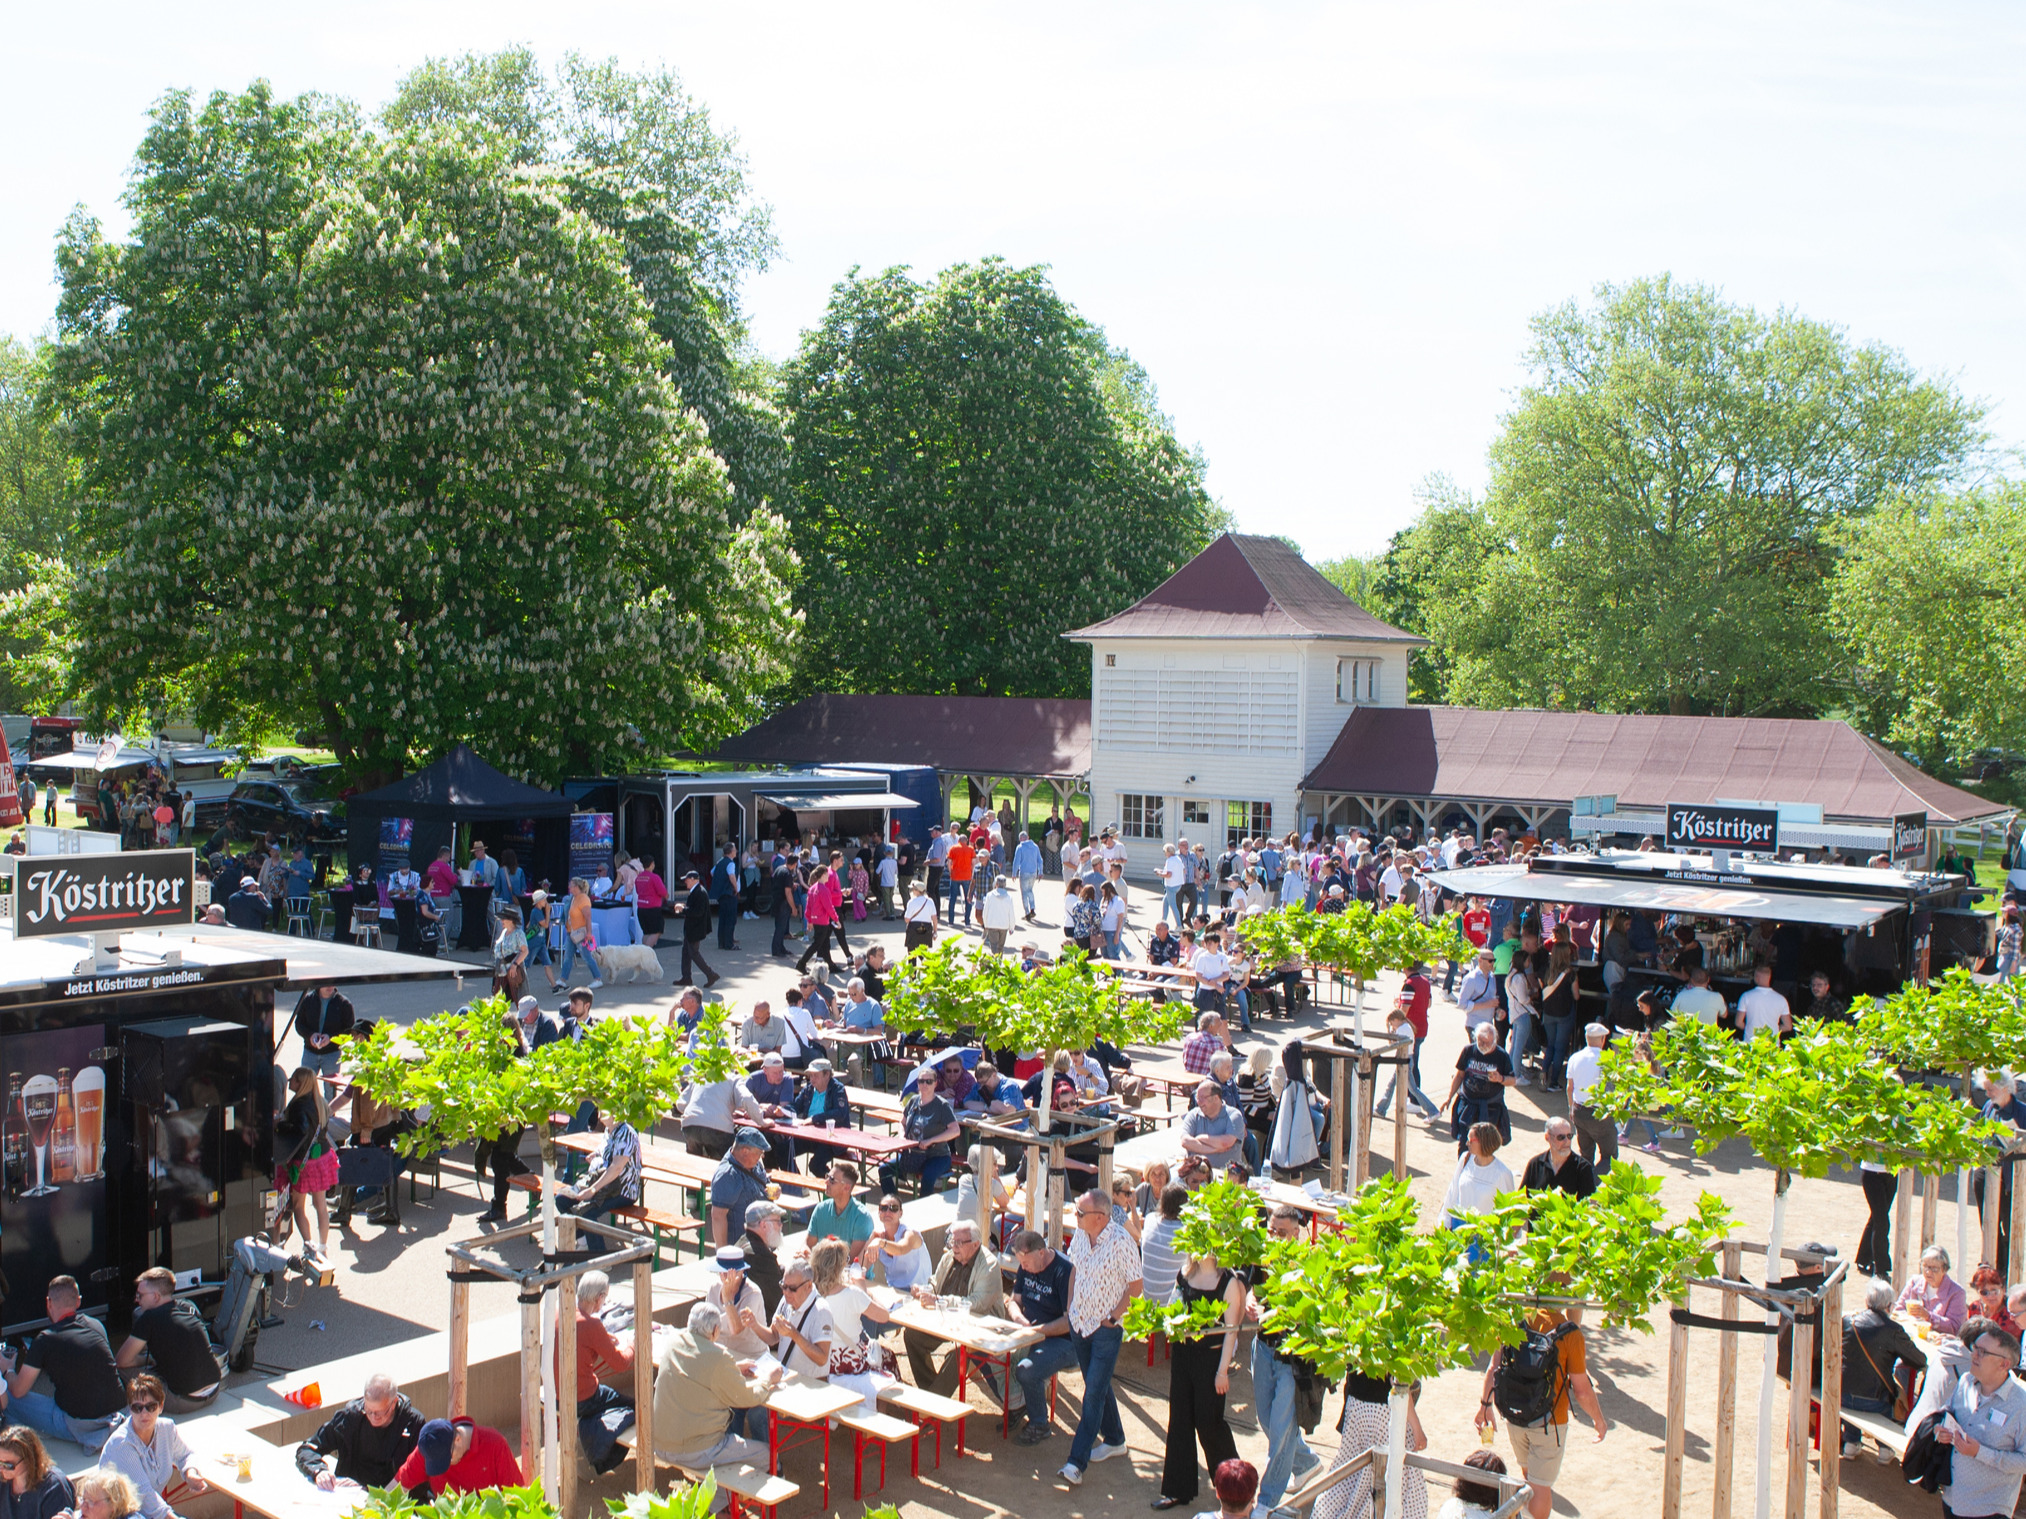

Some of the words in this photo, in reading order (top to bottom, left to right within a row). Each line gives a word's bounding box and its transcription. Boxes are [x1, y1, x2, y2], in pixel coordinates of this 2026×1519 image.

[1672, 811, 1773, 844] Köstritzer
[1665, 870, 1682, 879] Jetzt
[1683, 871, 1717, 882] Köstritzer
[26, 869, 185, 924] Köstritzer
[64, 980, 93, 996] Jetzt
[95, 976, 149, 993] Köstritzer
[152, 971, 204, 988] genießen.
